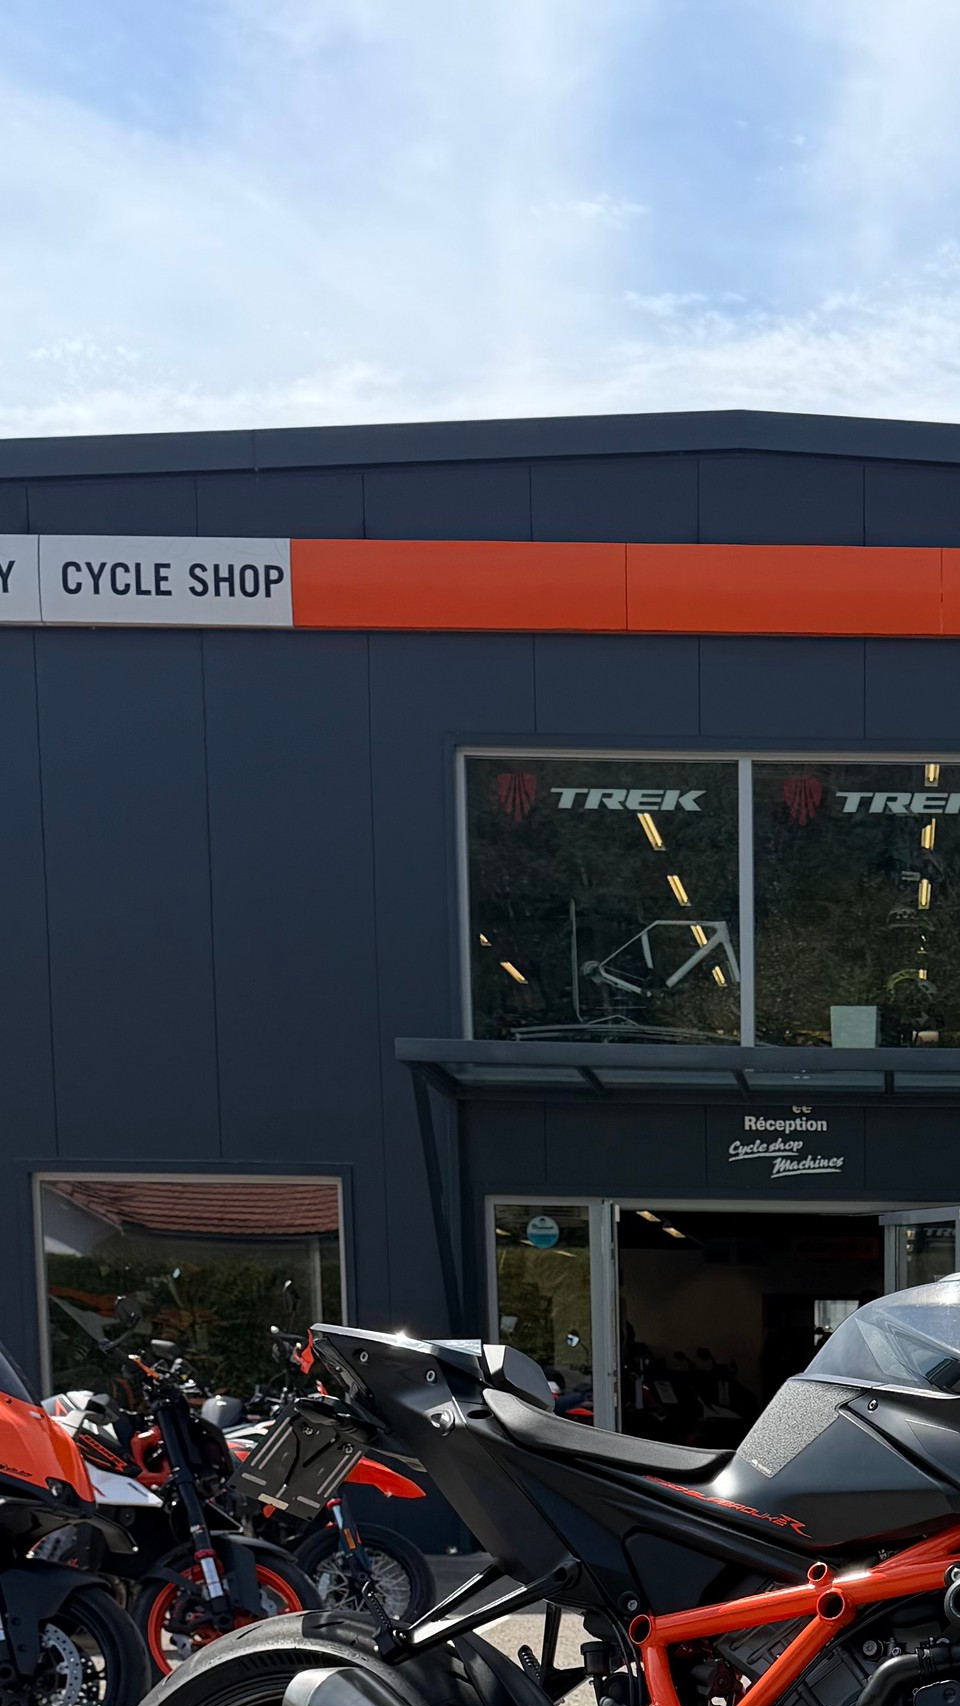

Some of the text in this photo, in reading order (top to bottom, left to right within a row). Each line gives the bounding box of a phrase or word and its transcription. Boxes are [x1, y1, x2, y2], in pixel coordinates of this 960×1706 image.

[61, 561, 172, 596] CYCLE
[188, 563, 284, 598] SHOP
[550, 787, 707, 812] TREK
[744, 1115, 828, 1134] Réception
[728, 1137, 804, 1157] Cycle shop
[772, 1154, 845, 1174] Machines
